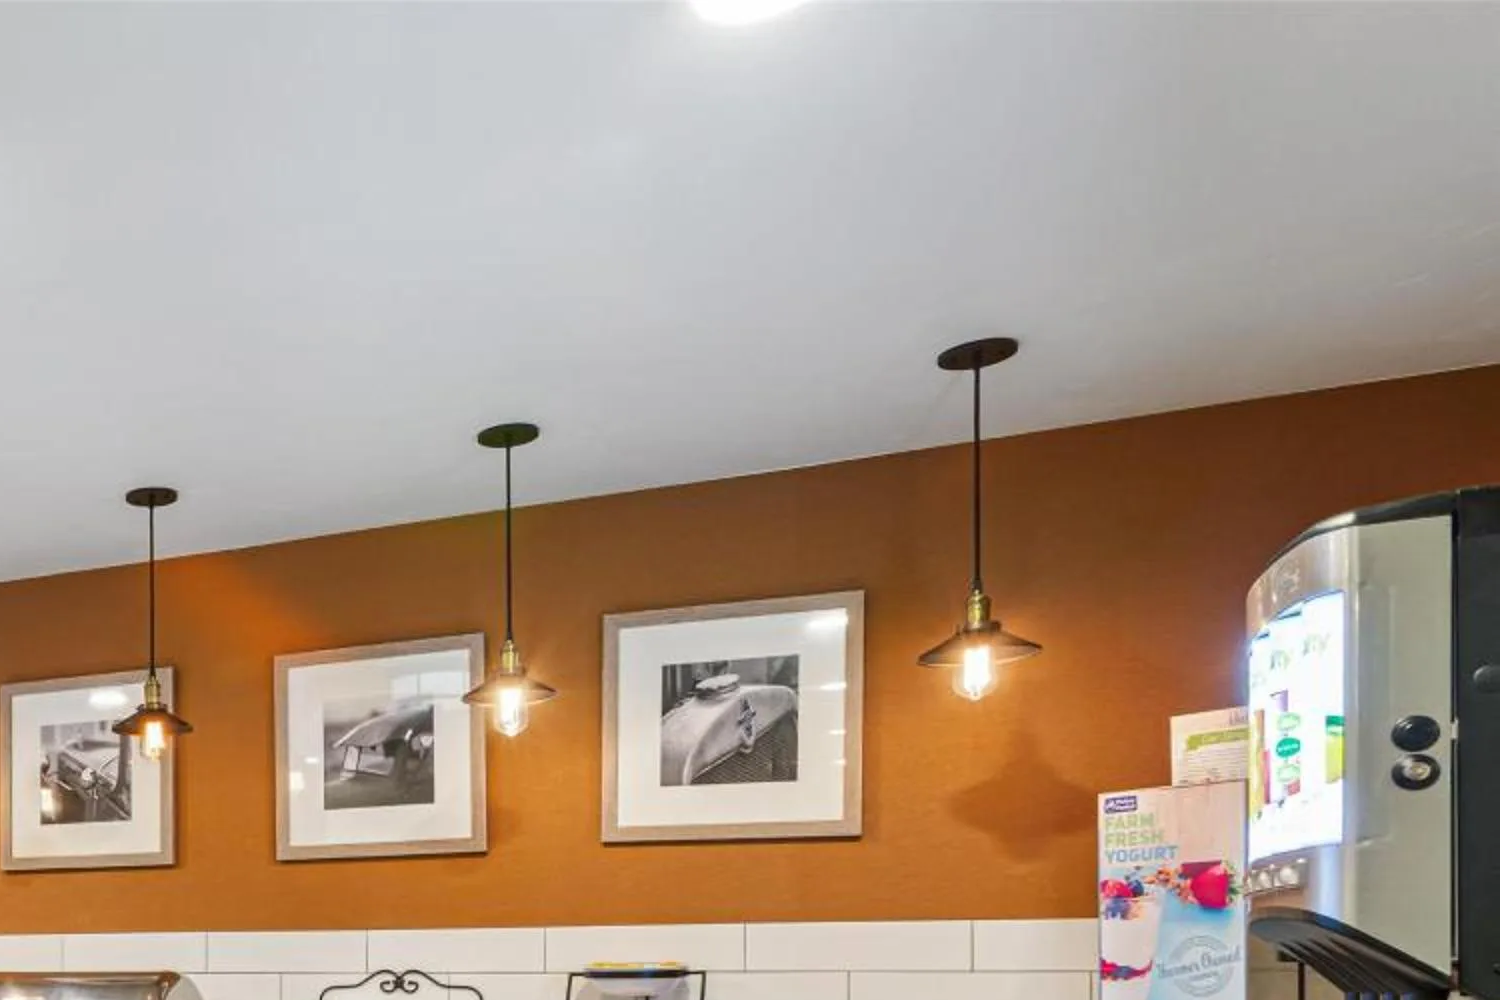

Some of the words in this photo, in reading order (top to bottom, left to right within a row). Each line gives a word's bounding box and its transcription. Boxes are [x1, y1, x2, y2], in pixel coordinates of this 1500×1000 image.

[1105, 813, 1154, 830] FARM
[1105, 830, 1164, 848] FRESH
[1105, 845, 1178, 863] YOGURT
